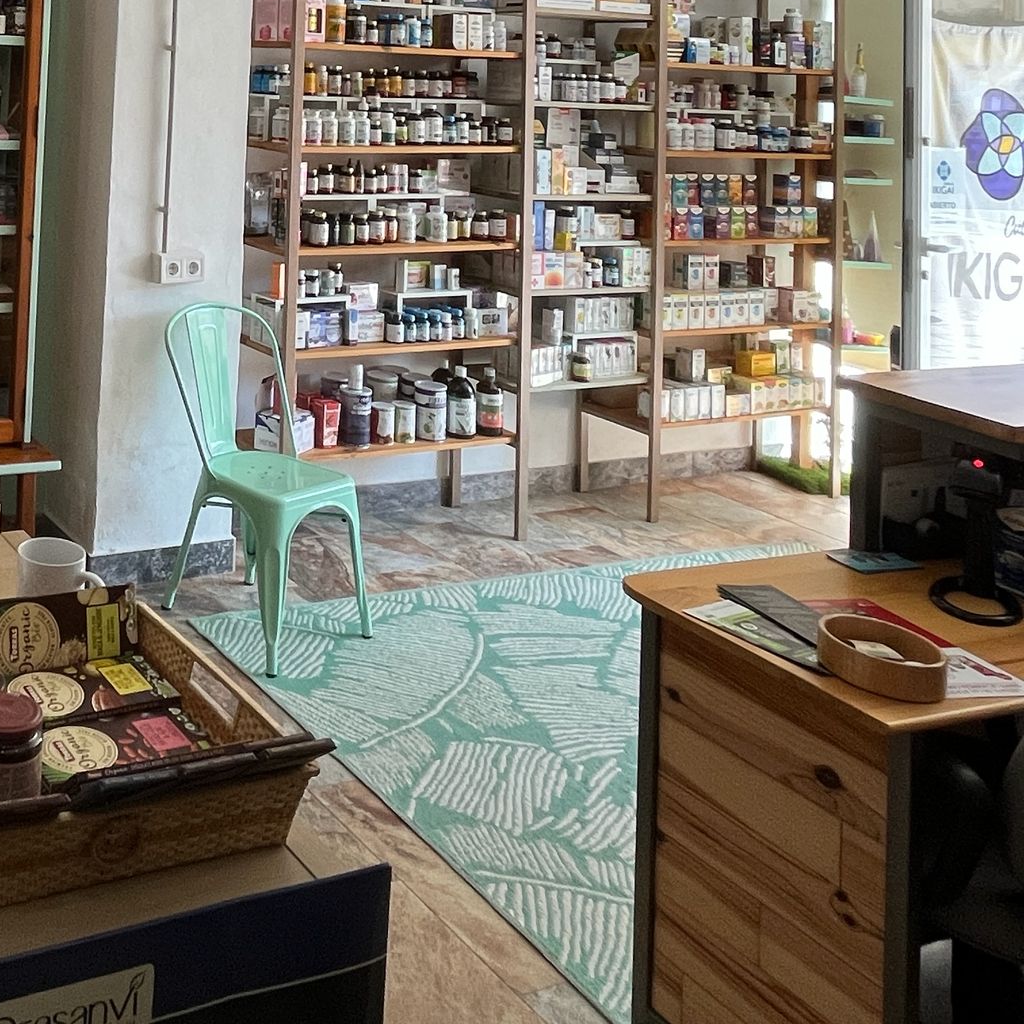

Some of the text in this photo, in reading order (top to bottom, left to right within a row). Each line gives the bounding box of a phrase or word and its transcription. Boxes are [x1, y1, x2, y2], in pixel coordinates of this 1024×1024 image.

[9, 626, 19, 663] TORRAS
[19, 605, 35, 673] Organic
[60, 729, 97, 769] Organic
